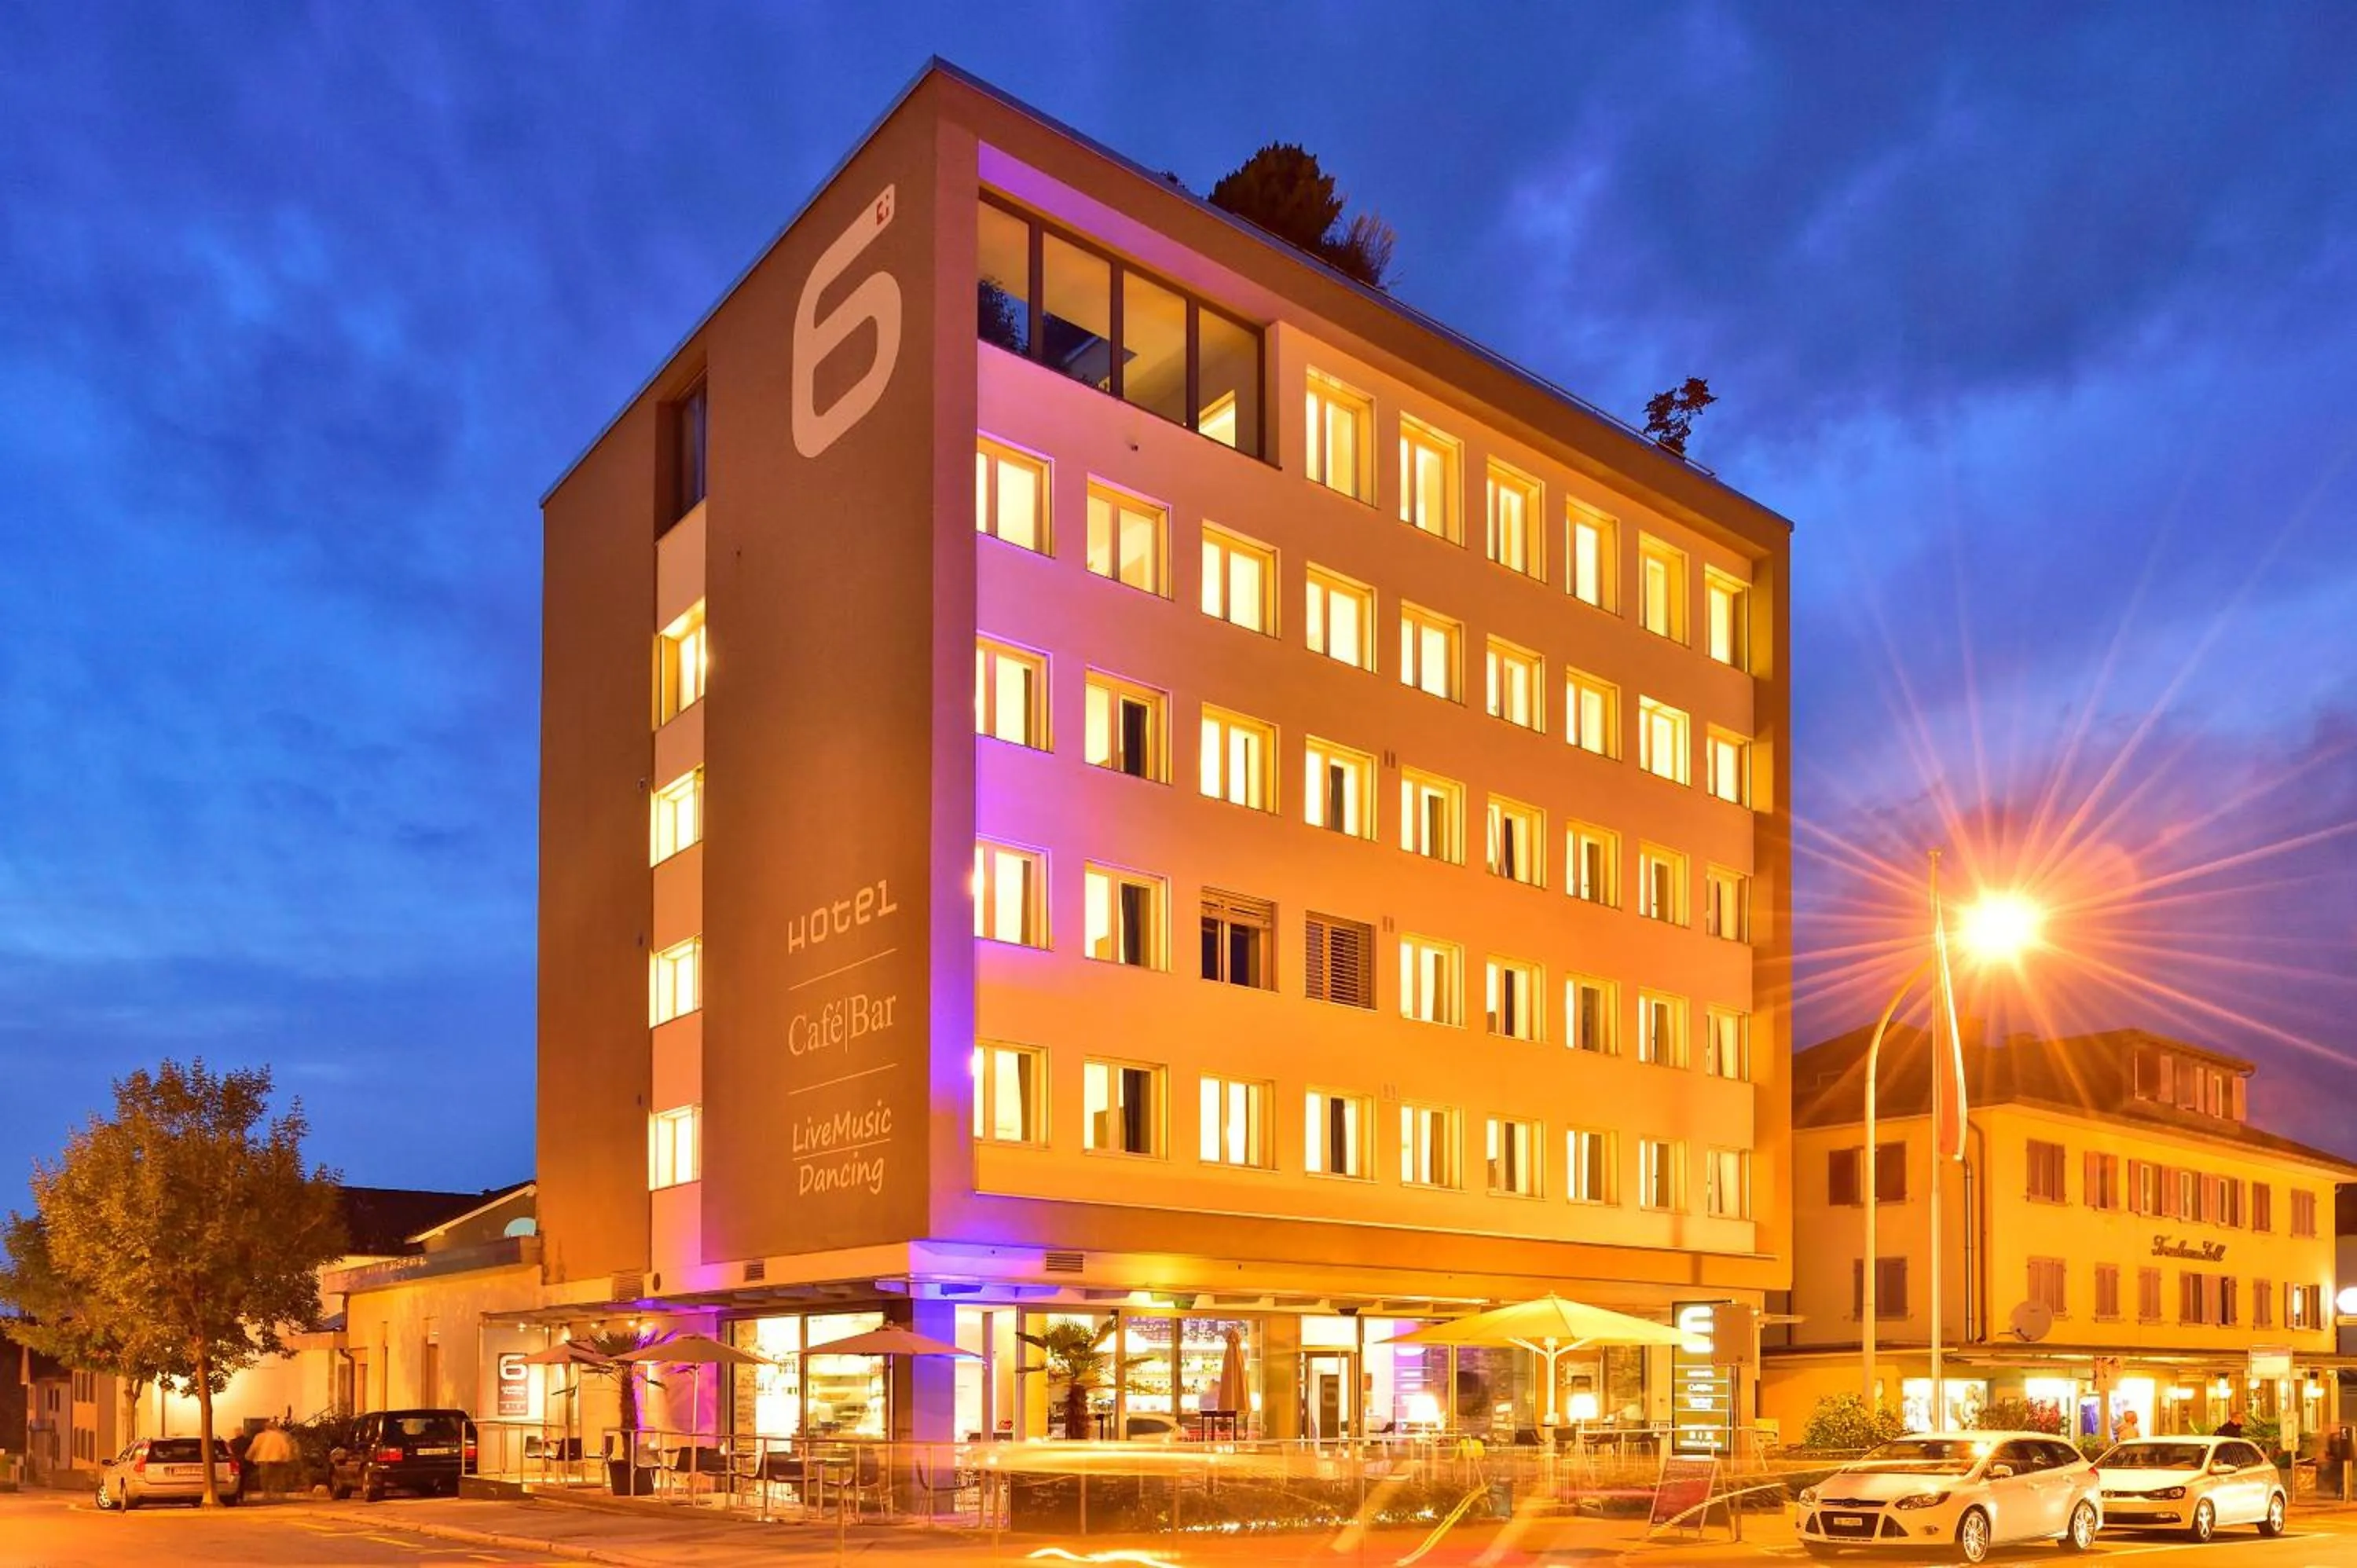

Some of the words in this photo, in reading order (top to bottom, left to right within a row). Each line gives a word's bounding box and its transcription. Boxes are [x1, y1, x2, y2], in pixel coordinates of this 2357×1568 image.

[792, 183, 902, 458] 6
[788, 879, 898, 955] Hotel
[792, 1100, 893, 1152] LiveMusic
[798, 1151, 885, 1196] Dancing
[499, 1354, 528, 1380] 6
